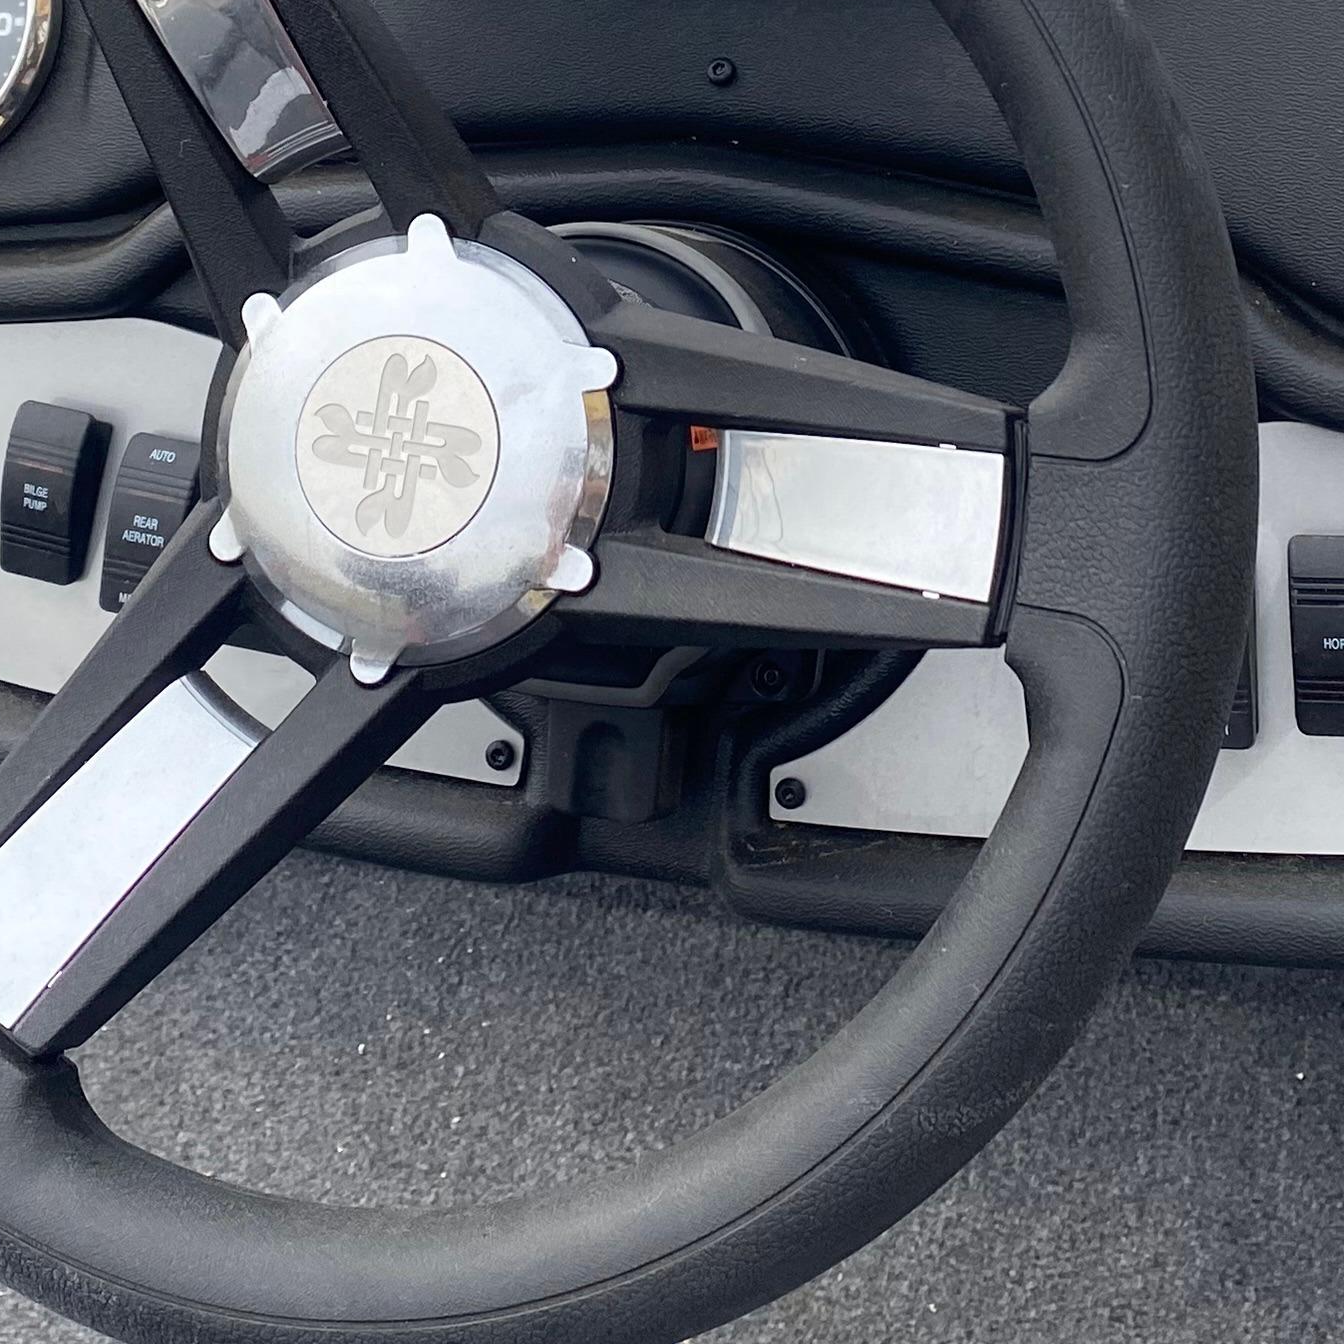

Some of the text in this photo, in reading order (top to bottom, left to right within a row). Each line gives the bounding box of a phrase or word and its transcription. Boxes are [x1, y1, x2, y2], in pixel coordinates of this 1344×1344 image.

[149, 448, 176, 463] AUTO
[23, 483, 49, 498] BILGE
[23, 497, 48, 511] PUMP
[133, 514, 159, 531] REAR
[122, 530, 164, 548] AERATOR
